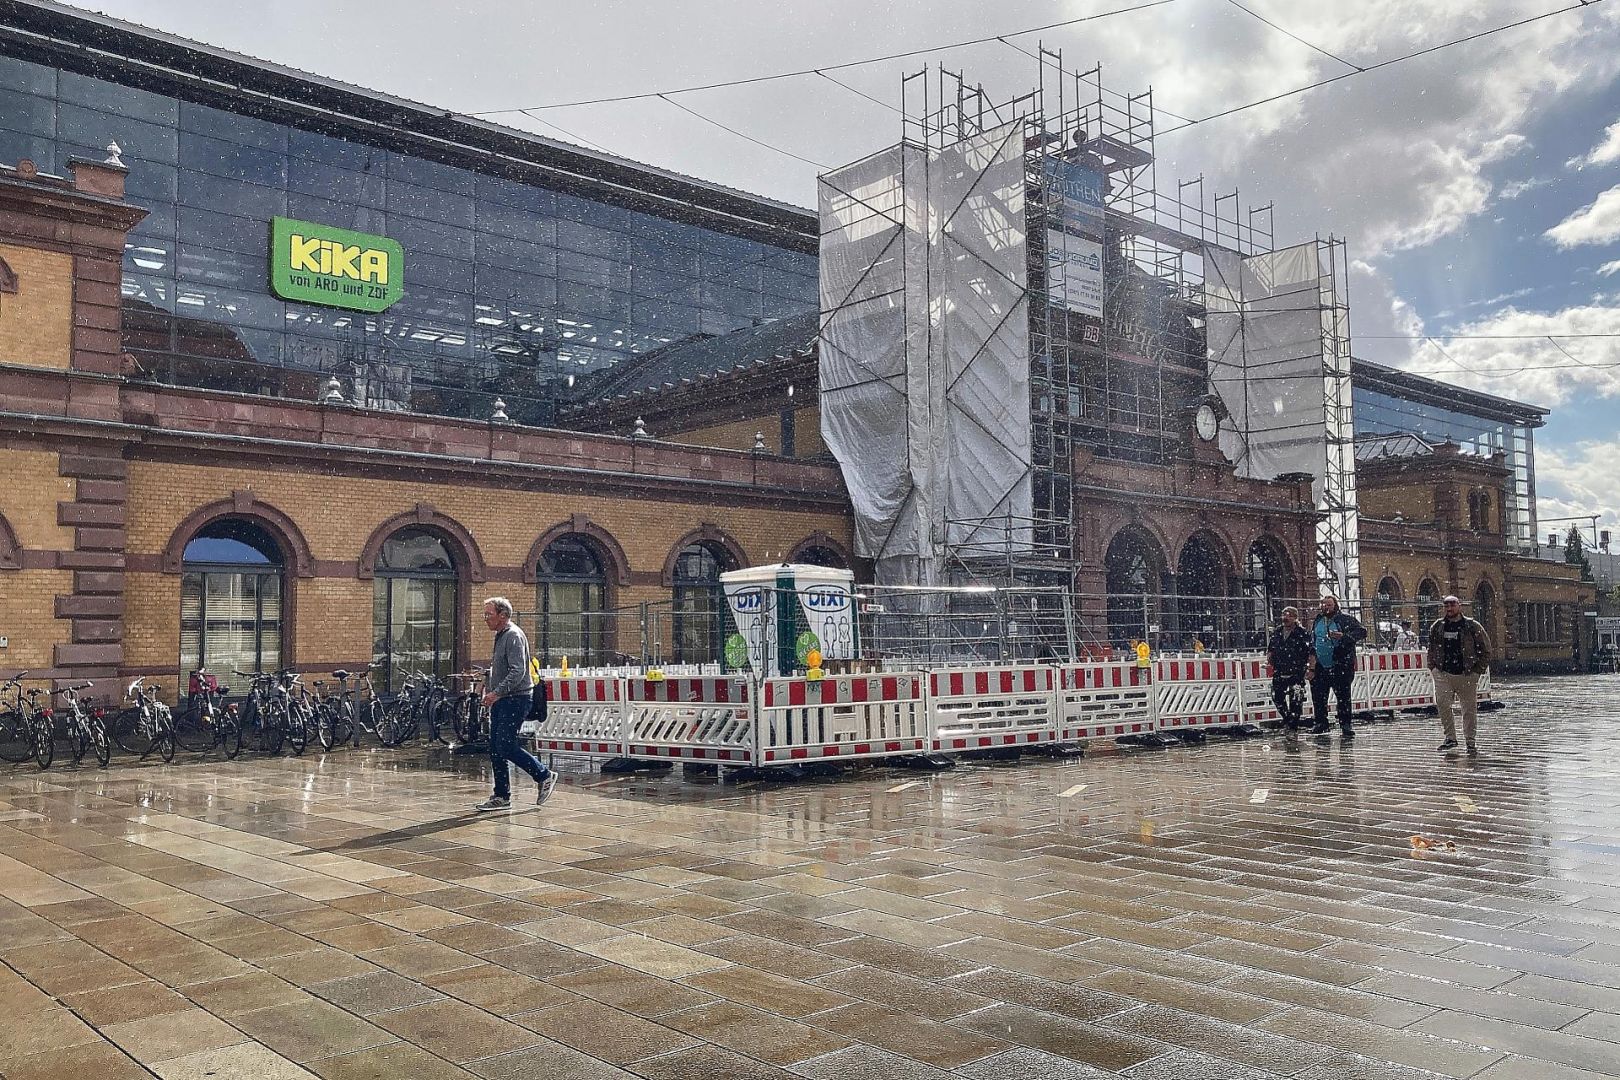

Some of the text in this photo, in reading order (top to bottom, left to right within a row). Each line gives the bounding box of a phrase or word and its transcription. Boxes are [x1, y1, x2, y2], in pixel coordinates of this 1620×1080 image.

[290, 274, 389, 300] von ARD und ZDF
[1084, 325, 1099, 341] DB
